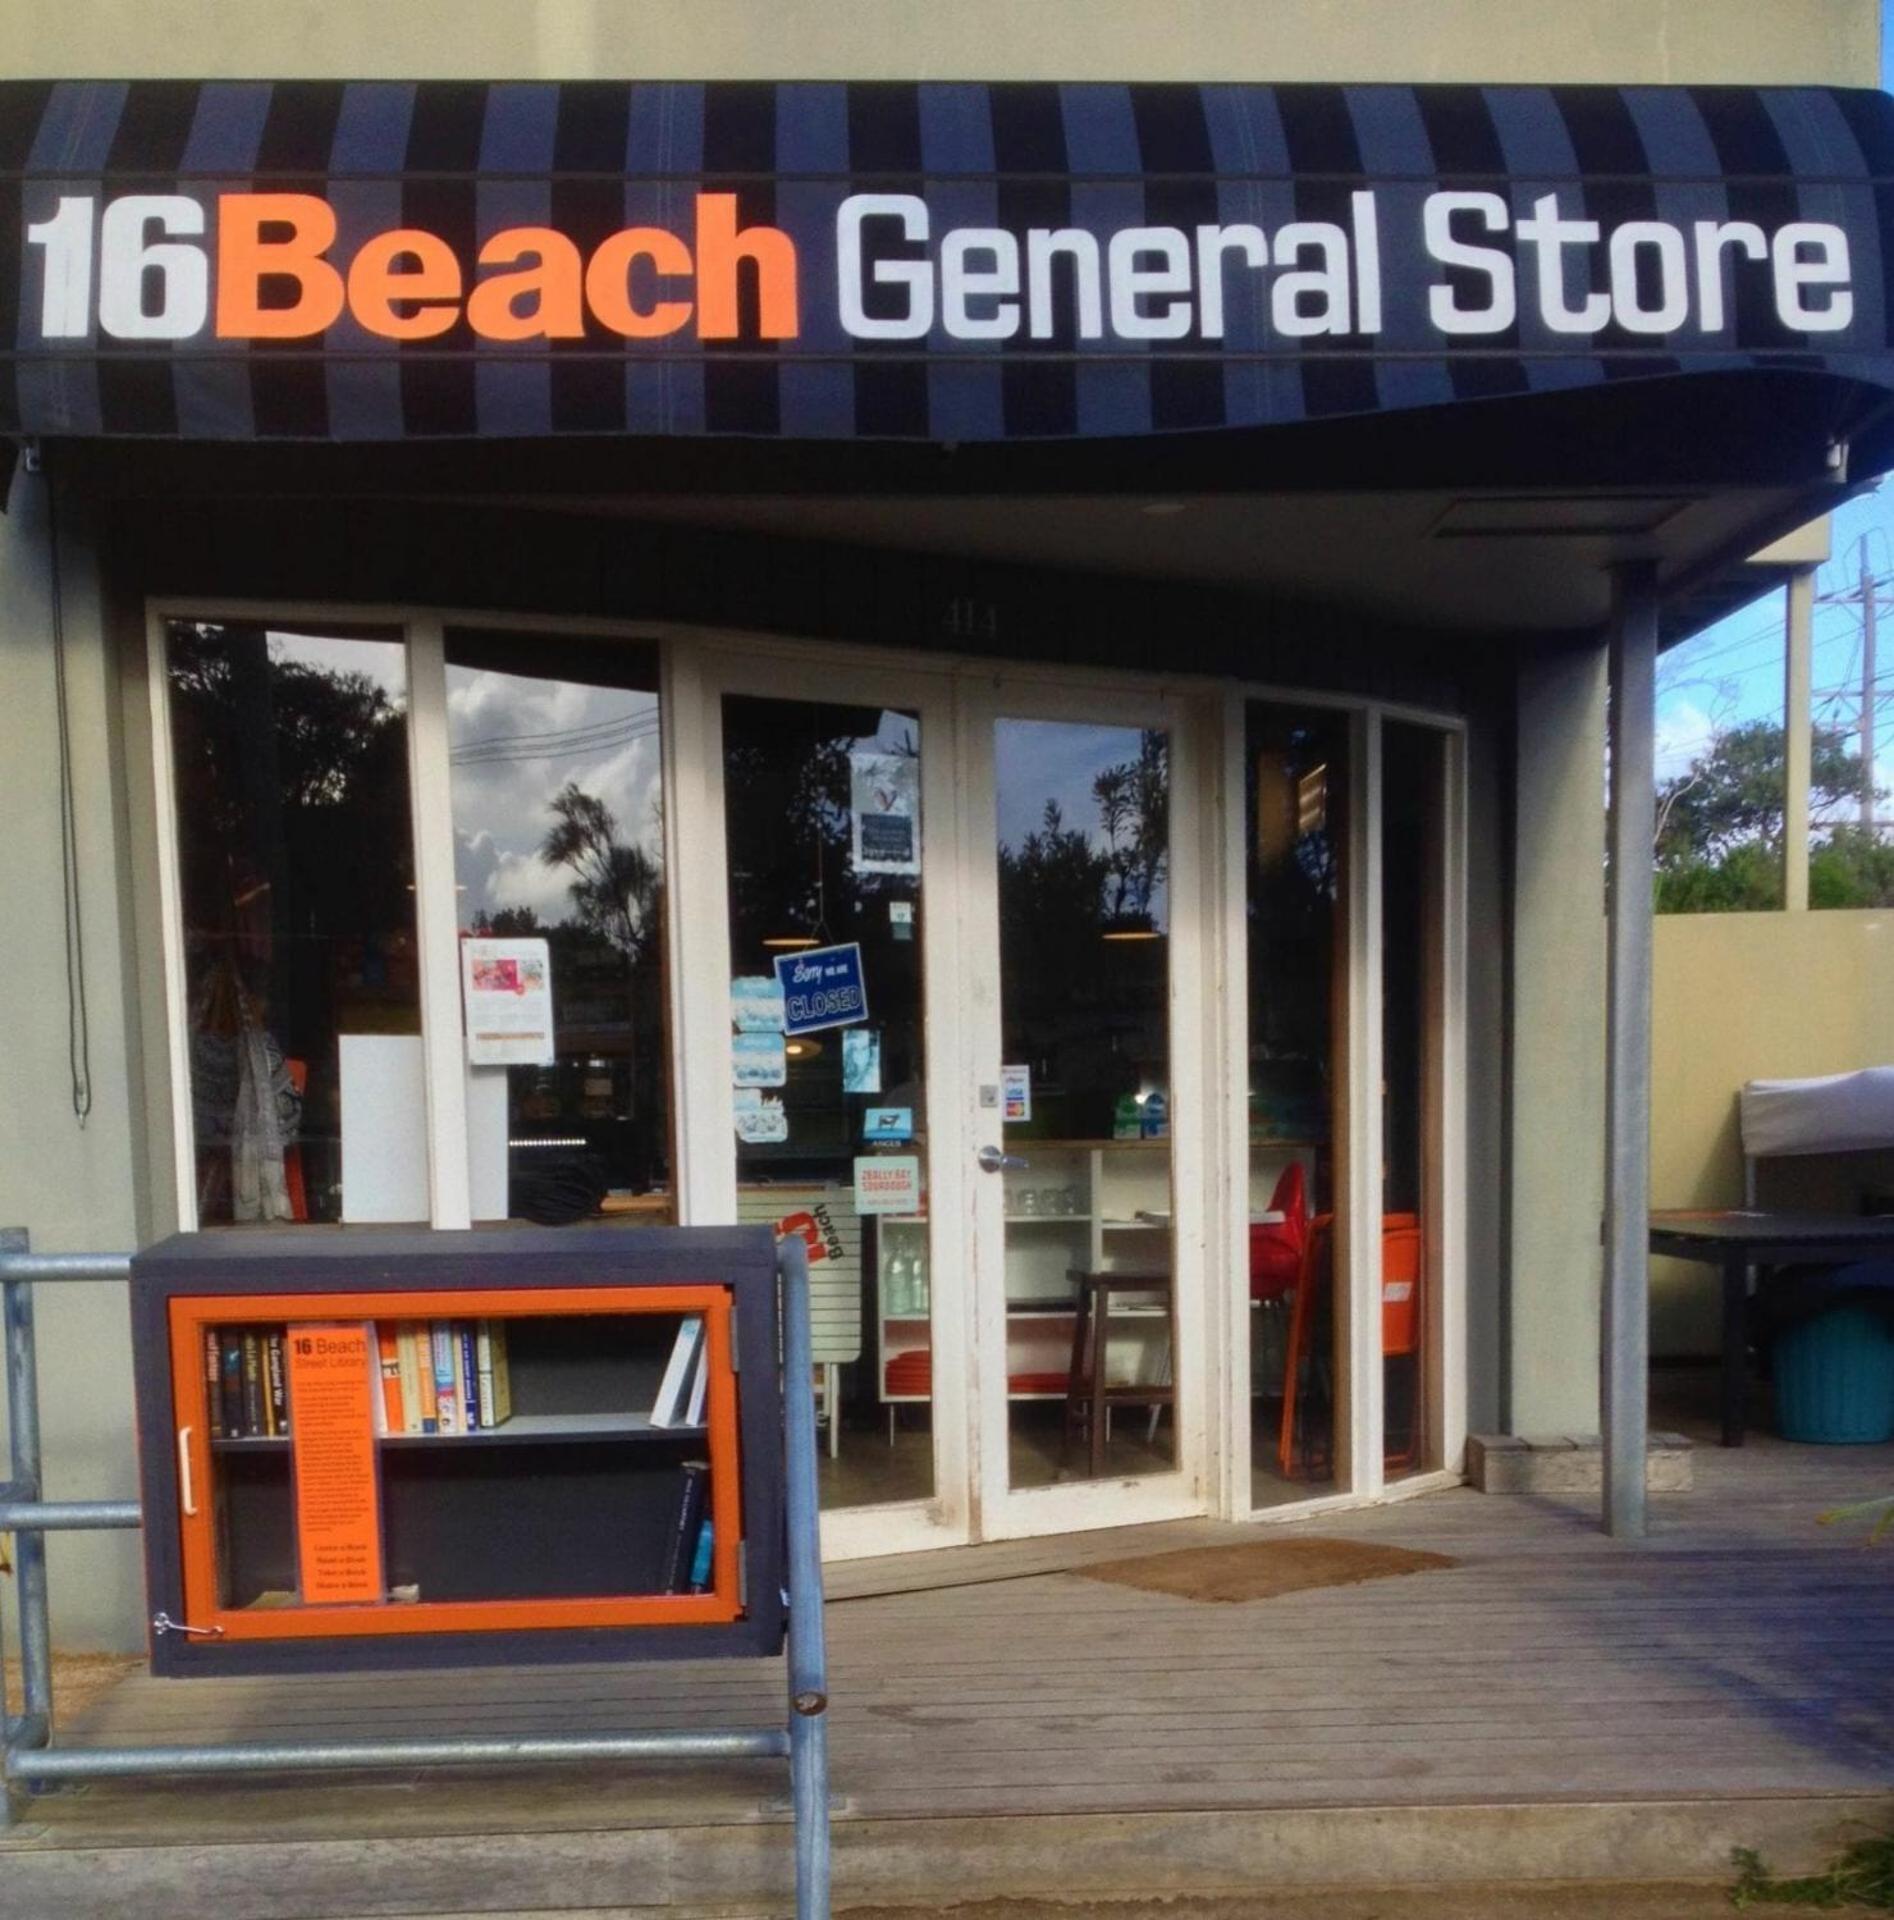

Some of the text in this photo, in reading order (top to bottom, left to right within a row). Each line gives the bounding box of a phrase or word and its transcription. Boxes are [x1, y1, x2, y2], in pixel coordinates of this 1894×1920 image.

[836, 190, 1382, 340] General
[1422, 191, 1854, 334] Store
[793, 962, 822, 985] Sorry
[787, 986, 861, 1021] CLOSED
[813, 1203, 844, 1260] Beach
[294, 1336, 367, 1355] 16 Beach
[330, 1357, 367, 1369] Library
